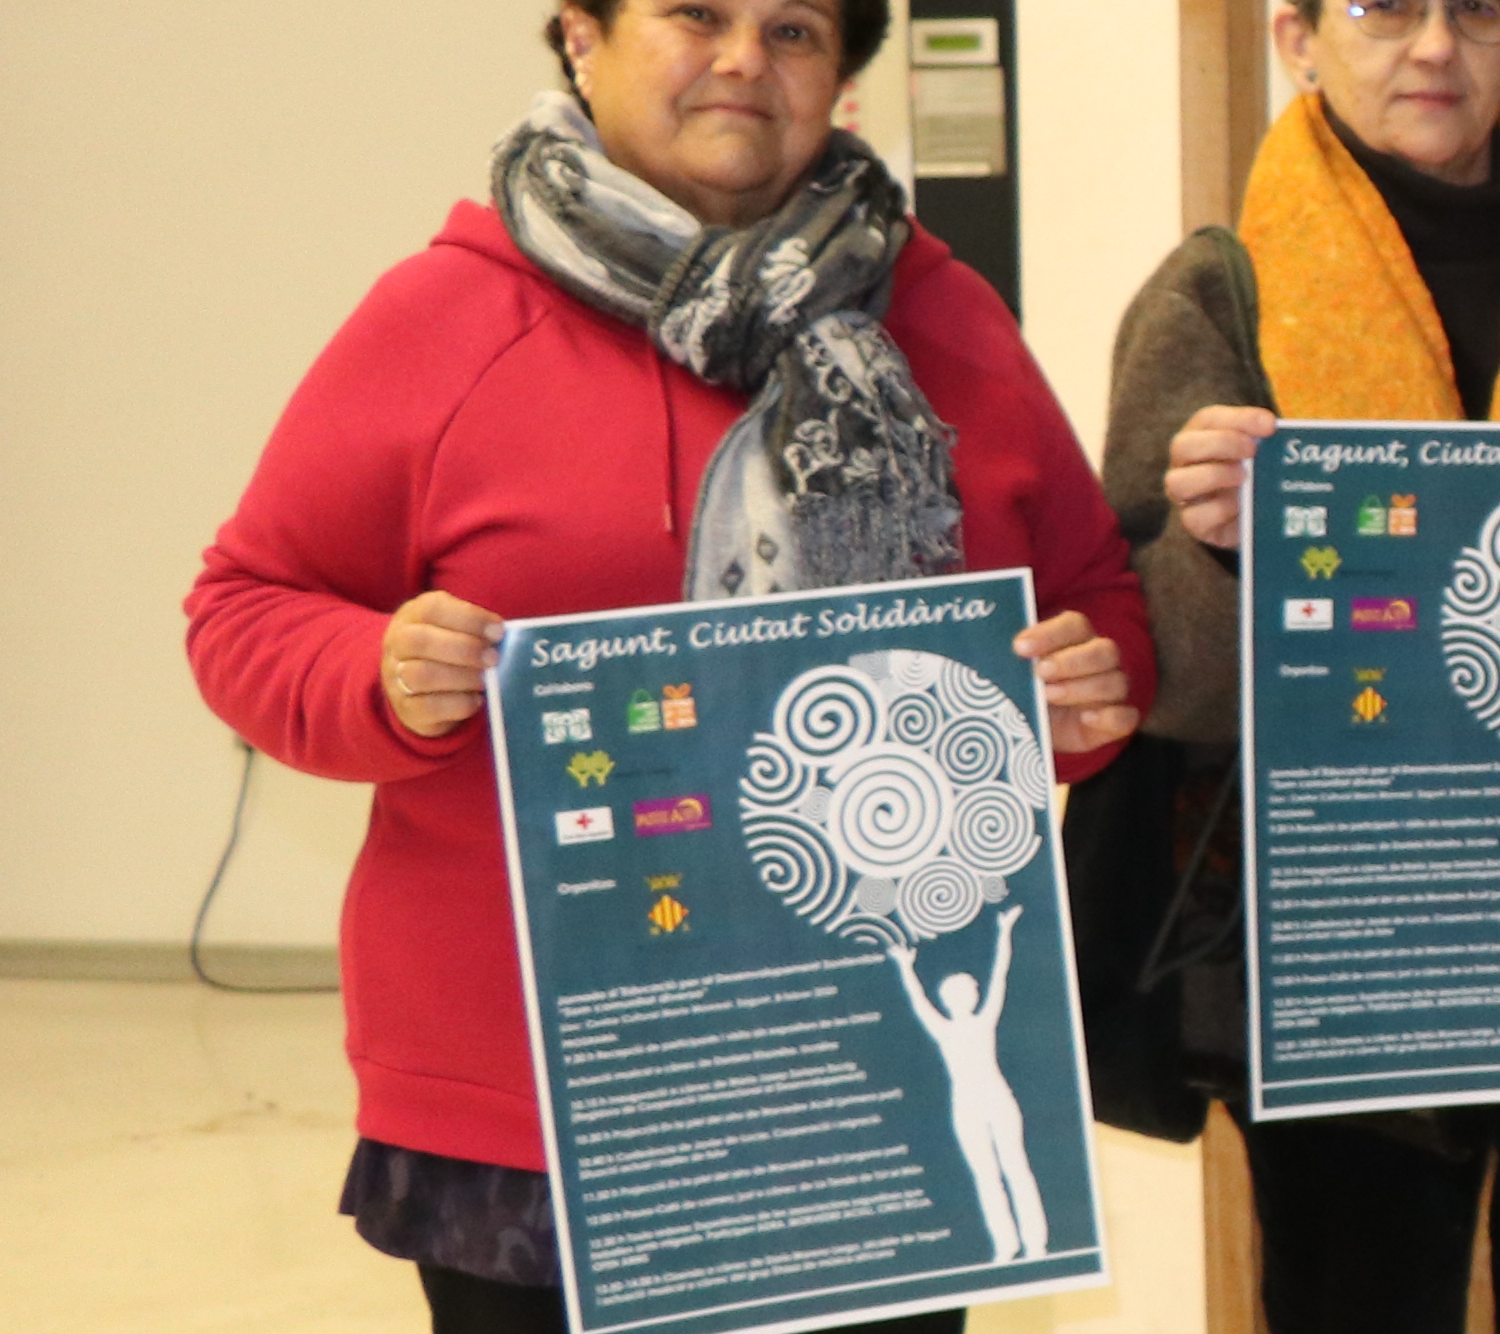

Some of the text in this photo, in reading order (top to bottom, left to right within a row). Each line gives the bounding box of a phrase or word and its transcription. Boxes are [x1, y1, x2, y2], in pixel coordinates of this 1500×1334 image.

[1282, 439, 1409, 473] Sagunt,
[532, 593, 996, 672] Sagunt, Ciutat Solidària
